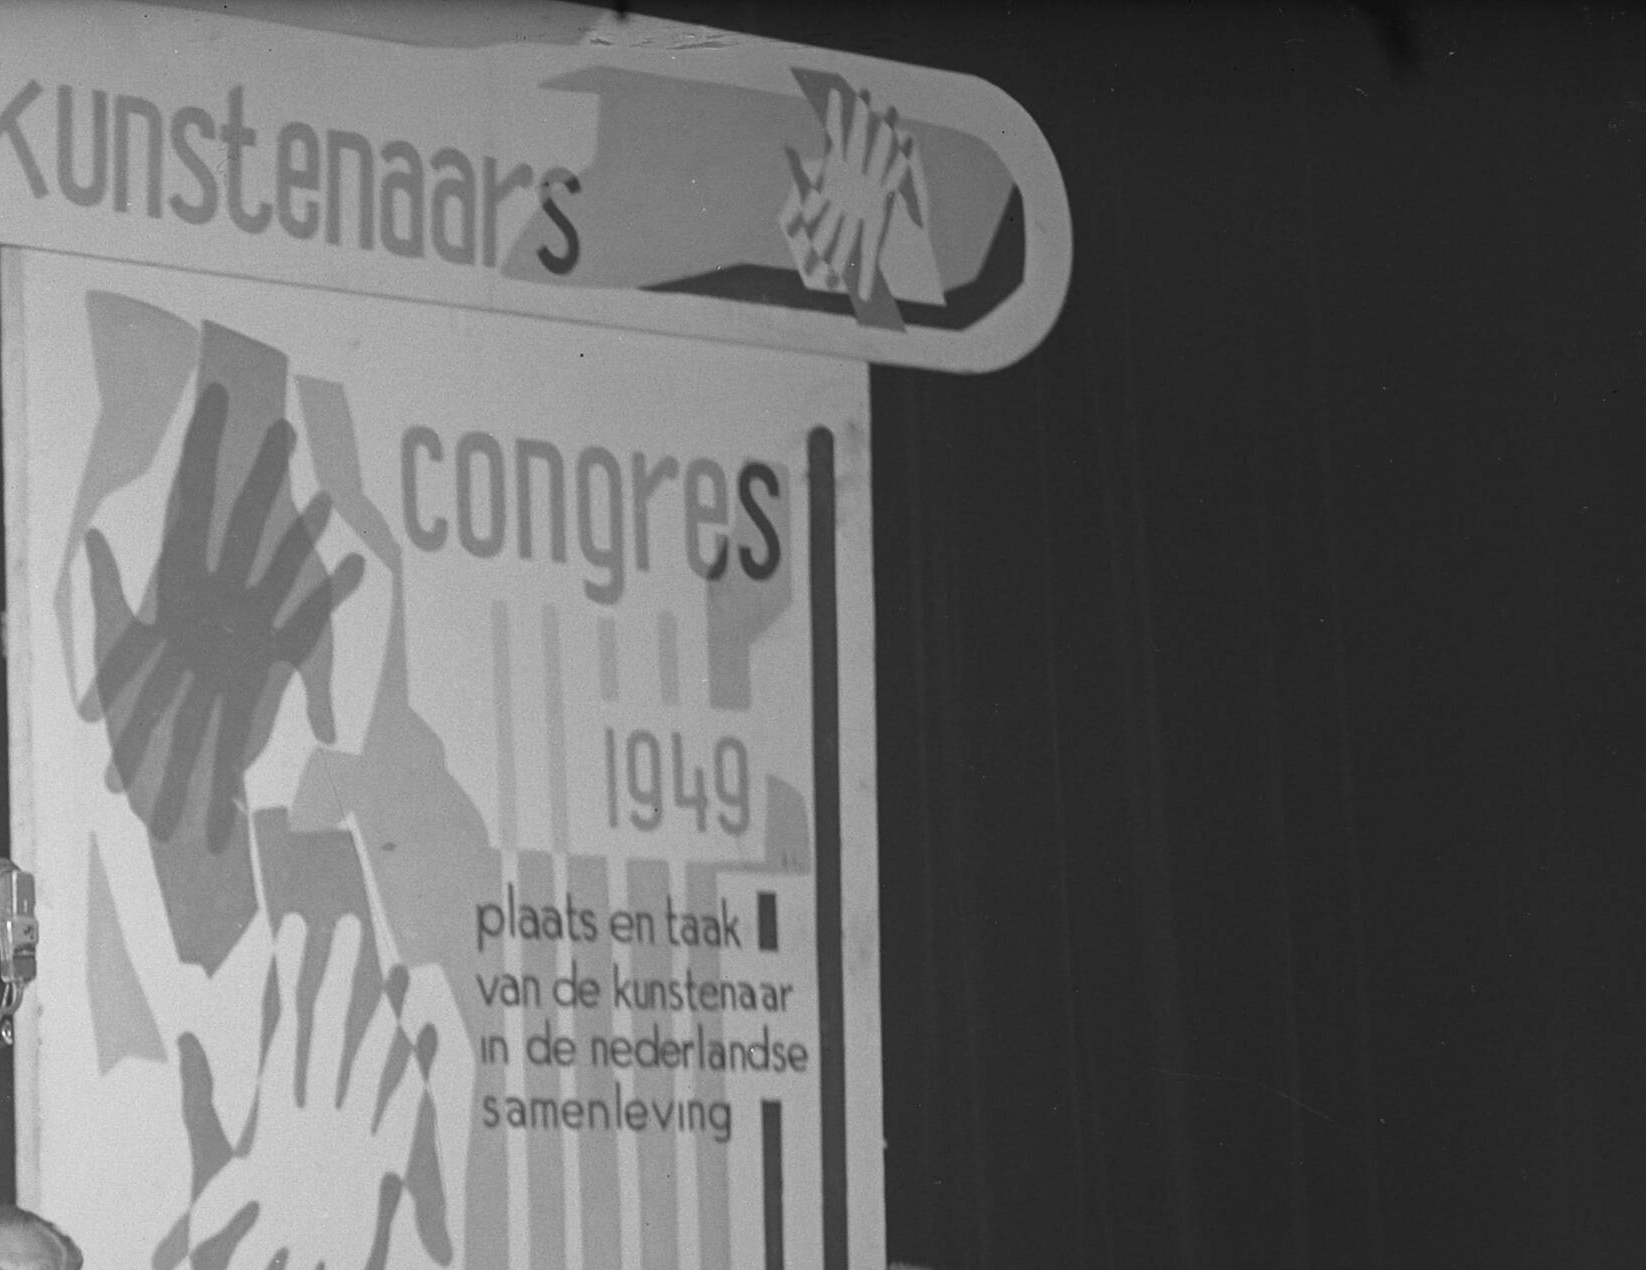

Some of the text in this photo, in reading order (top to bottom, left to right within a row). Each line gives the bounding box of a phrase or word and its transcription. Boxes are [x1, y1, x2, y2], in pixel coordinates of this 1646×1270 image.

[400, 425, 782, 604] congres
[604, 726, 752, 836] 1949
[476, 882, 742, 952] plaats en taak
[475, 958, 794, 1012] van de kunstenaar
[480, 1019, 809, 1073] in de nederlandse
[482, 1080, 732, 1144] samenleving
